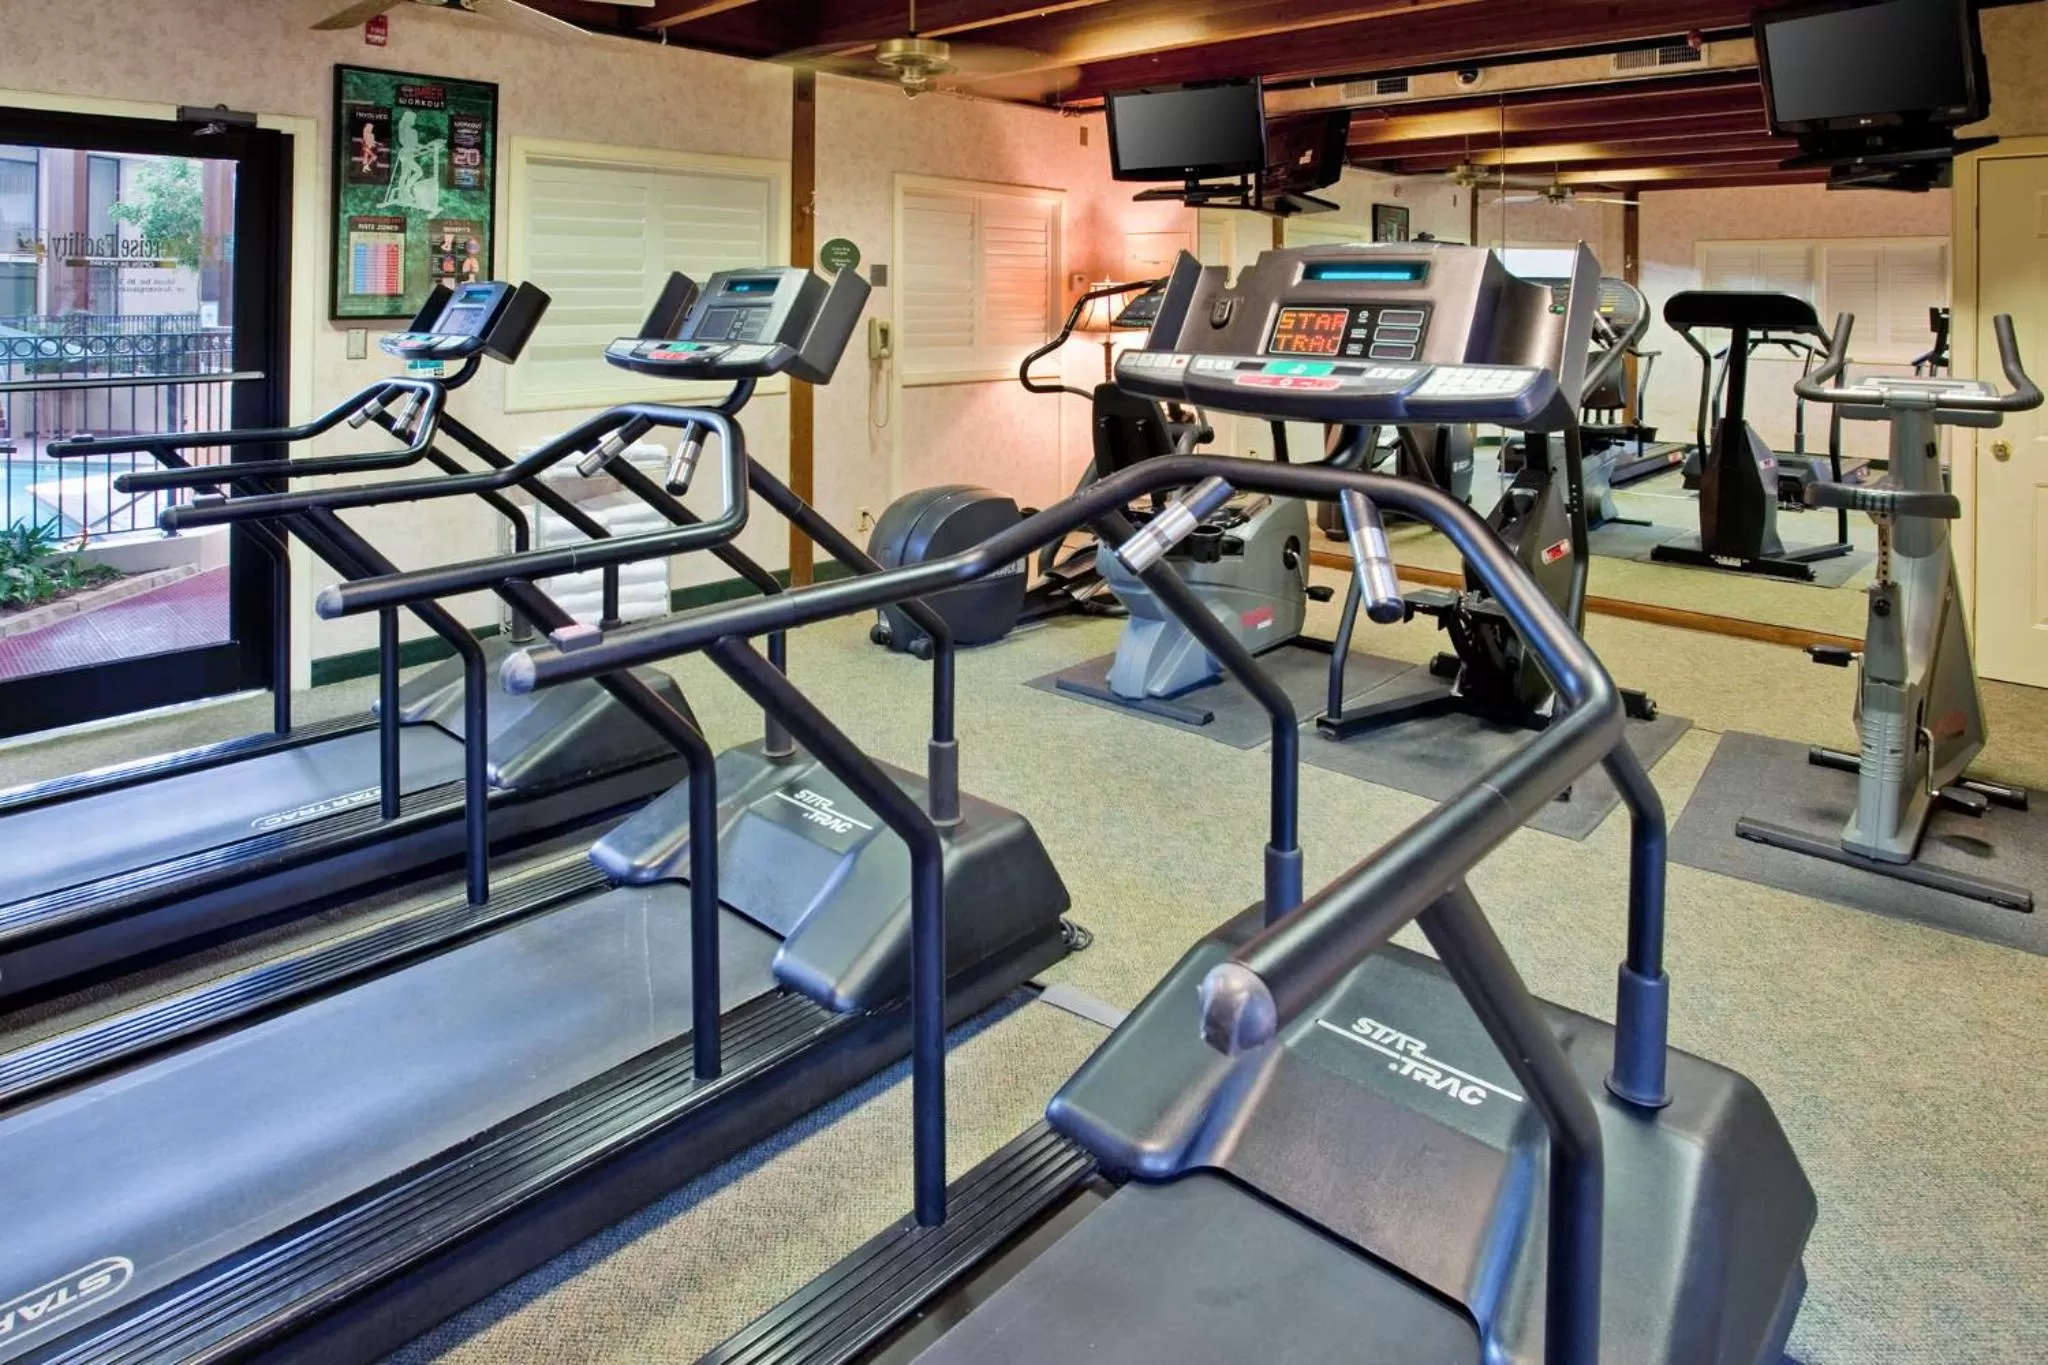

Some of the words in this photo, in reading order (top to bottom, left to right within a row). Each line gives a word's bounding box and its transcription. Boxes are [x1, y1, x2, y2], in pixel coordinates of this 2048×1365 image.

[398, 97, 445, 109] WORKOUT
[1279, 312, 1346, 331] STAR
[1276, 334, 1341, 353] TRAC
[794, 788, 835, 811] STAR
[1352, 1017, 1428, 1061] STAR
[1398, 1056, 1488, 1106] TRAC
